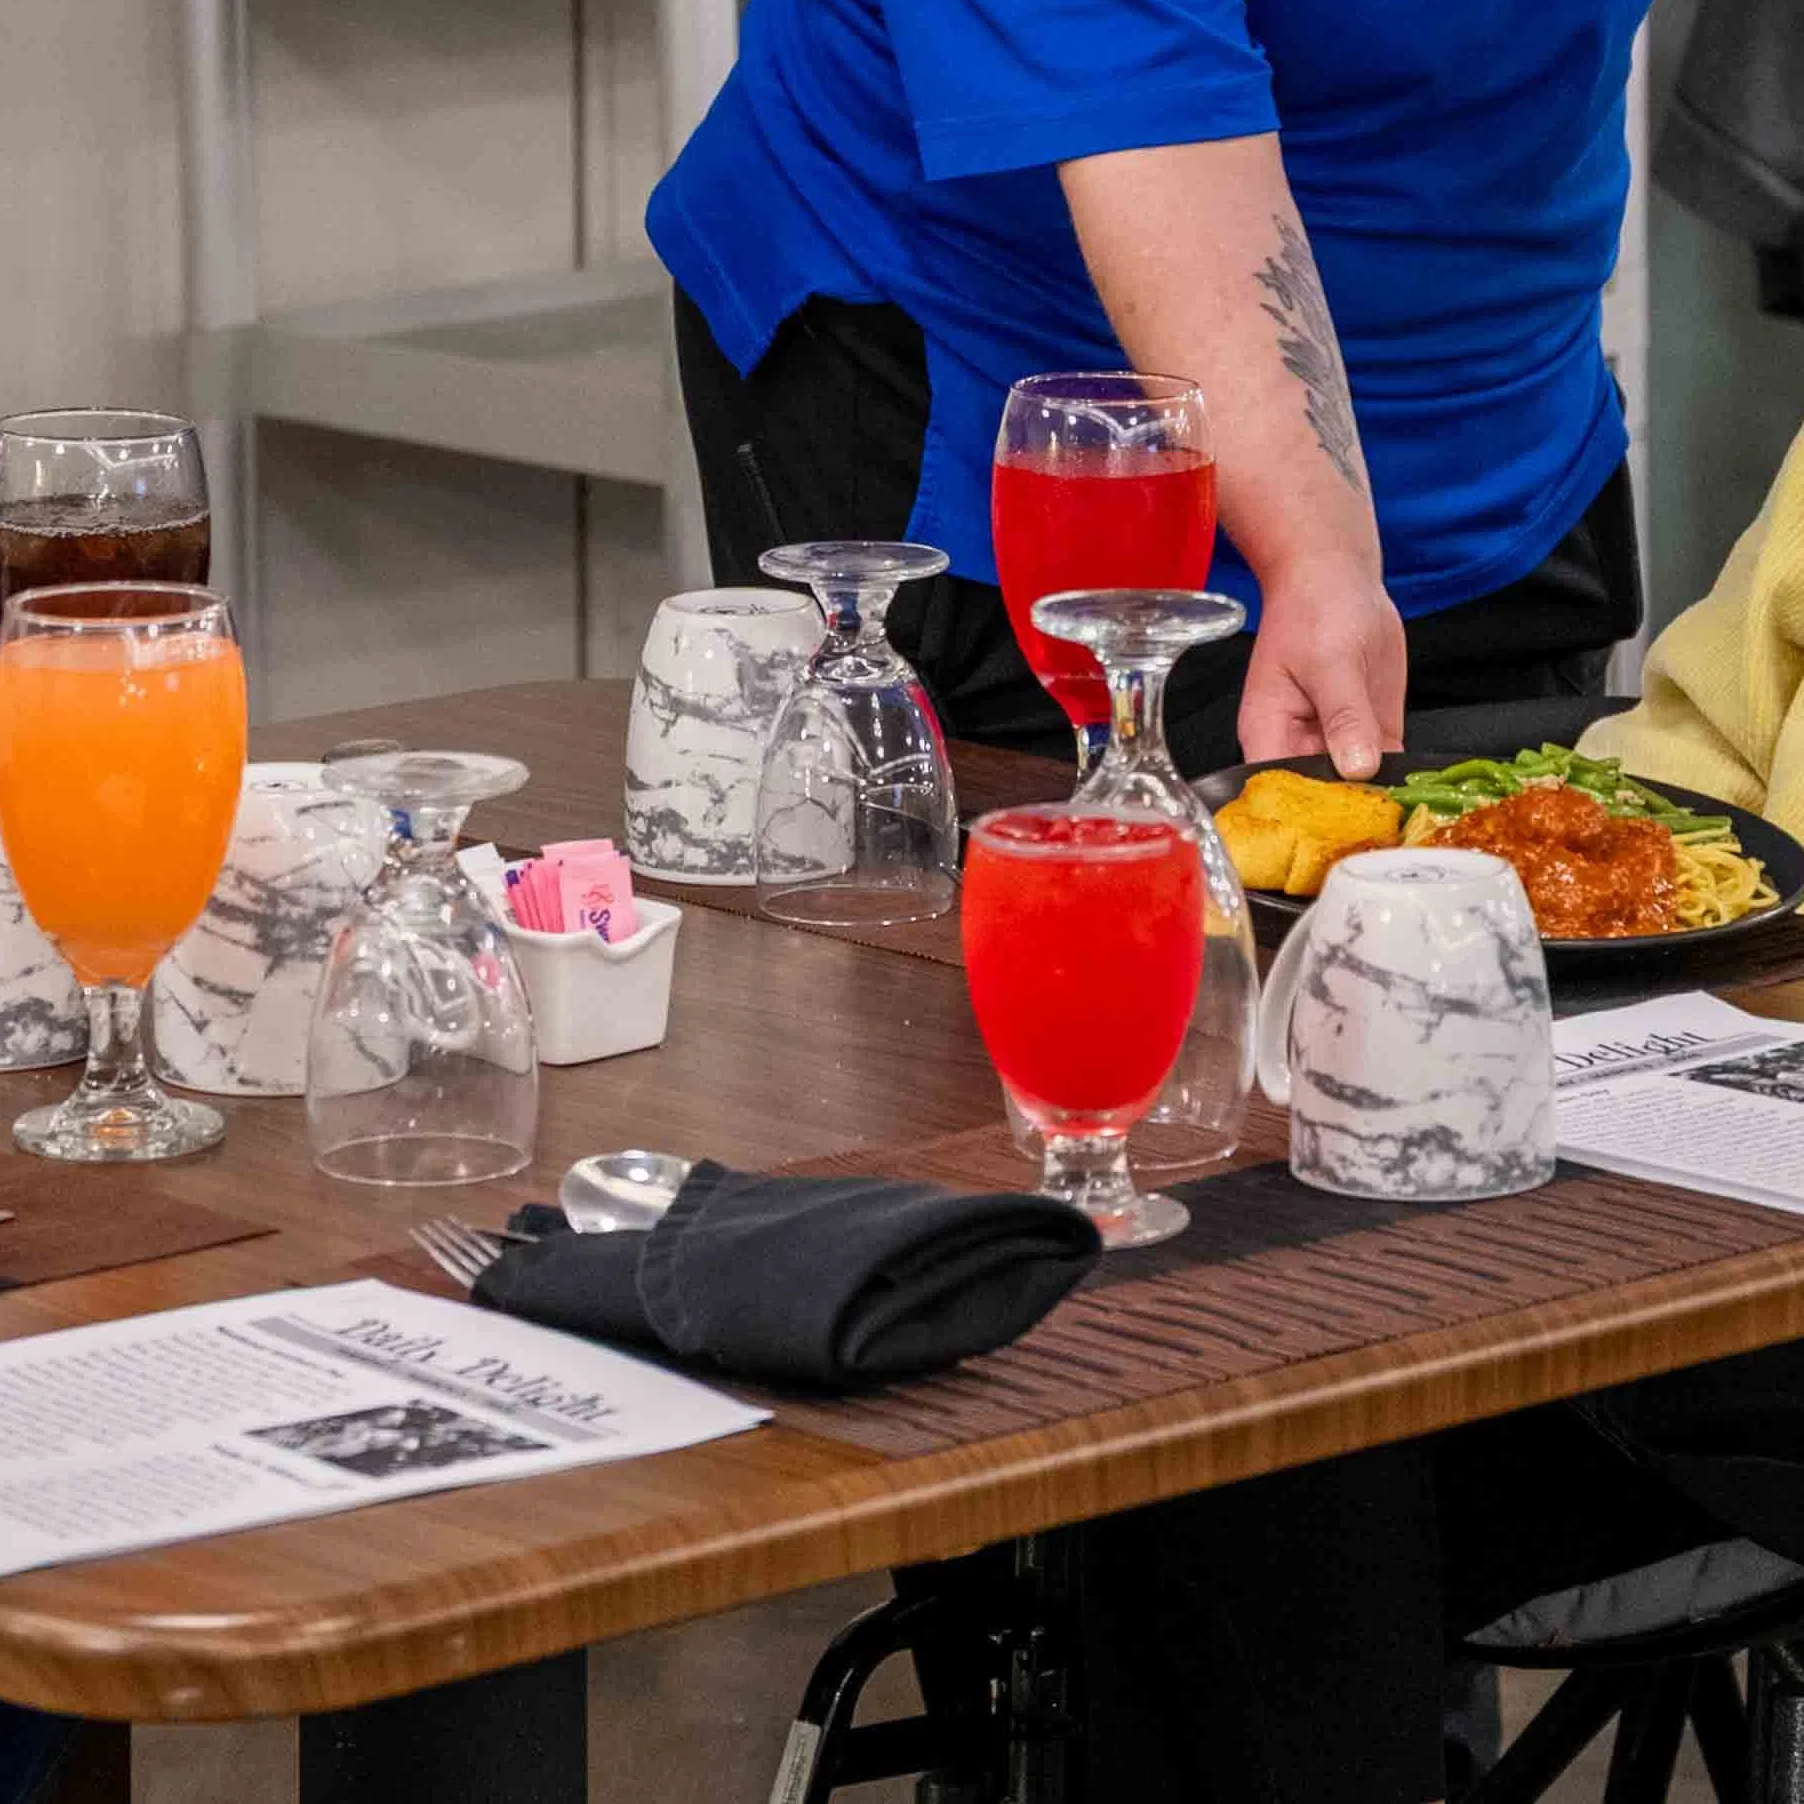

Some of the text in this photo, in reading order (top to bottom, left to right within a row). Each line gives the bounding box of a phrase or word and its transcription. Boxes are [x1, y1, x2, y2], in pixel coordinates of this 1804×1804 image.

[1555, 1030, 1716, 1069] Delight
[333, 1318, 446, 1364] Daily
[455, 1355, 618, 1423] Delight
